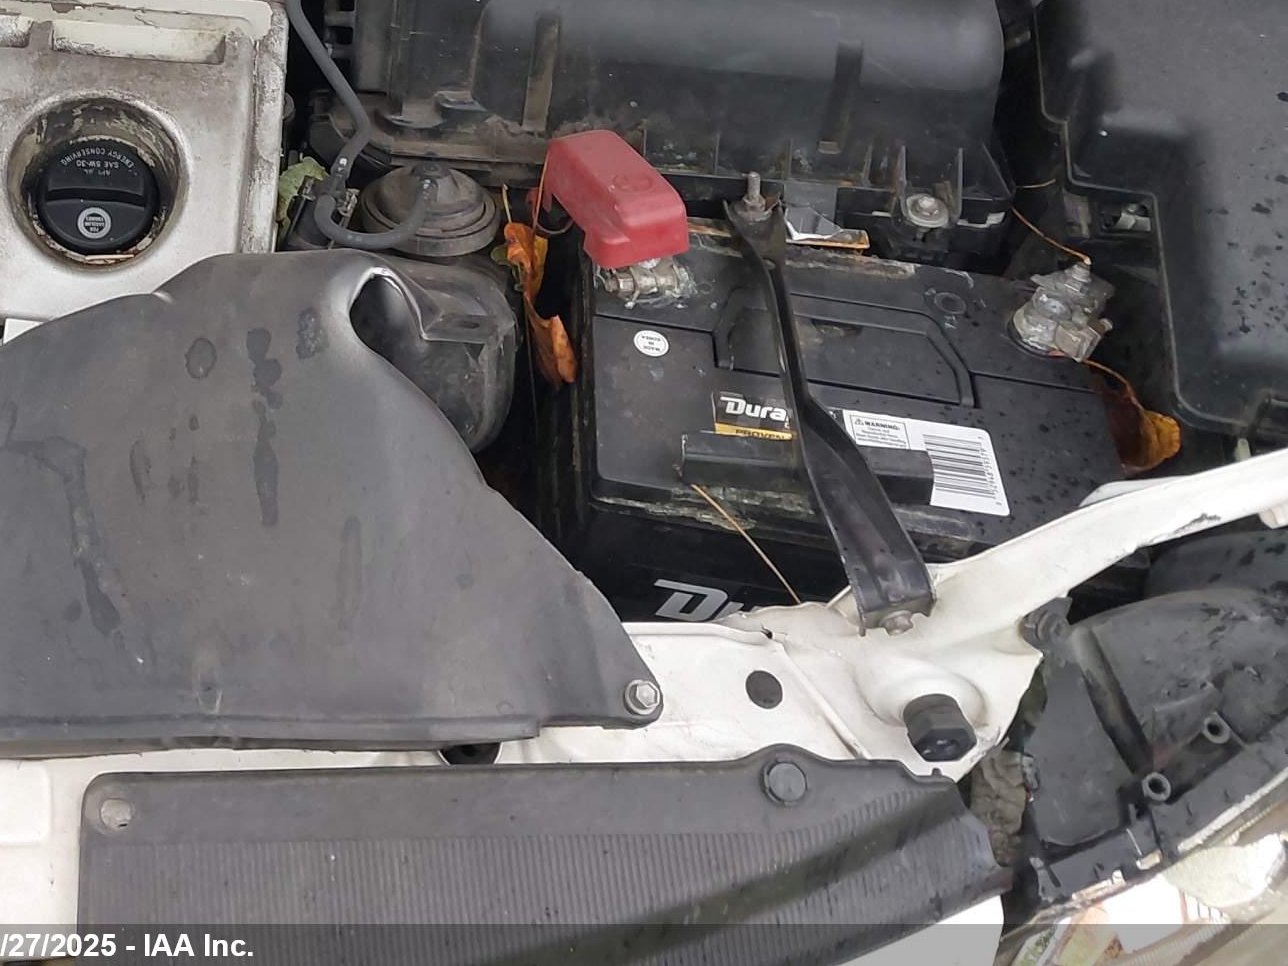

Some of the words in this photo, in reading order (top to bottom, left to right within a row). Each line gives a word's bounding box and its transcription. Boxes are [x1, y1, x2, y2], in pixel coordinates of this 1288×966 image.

[60, 147, 106, 166] CONSERVING
[108, 150, 135, 168] ENERGY
[719, 395, 790, 422] Dura
